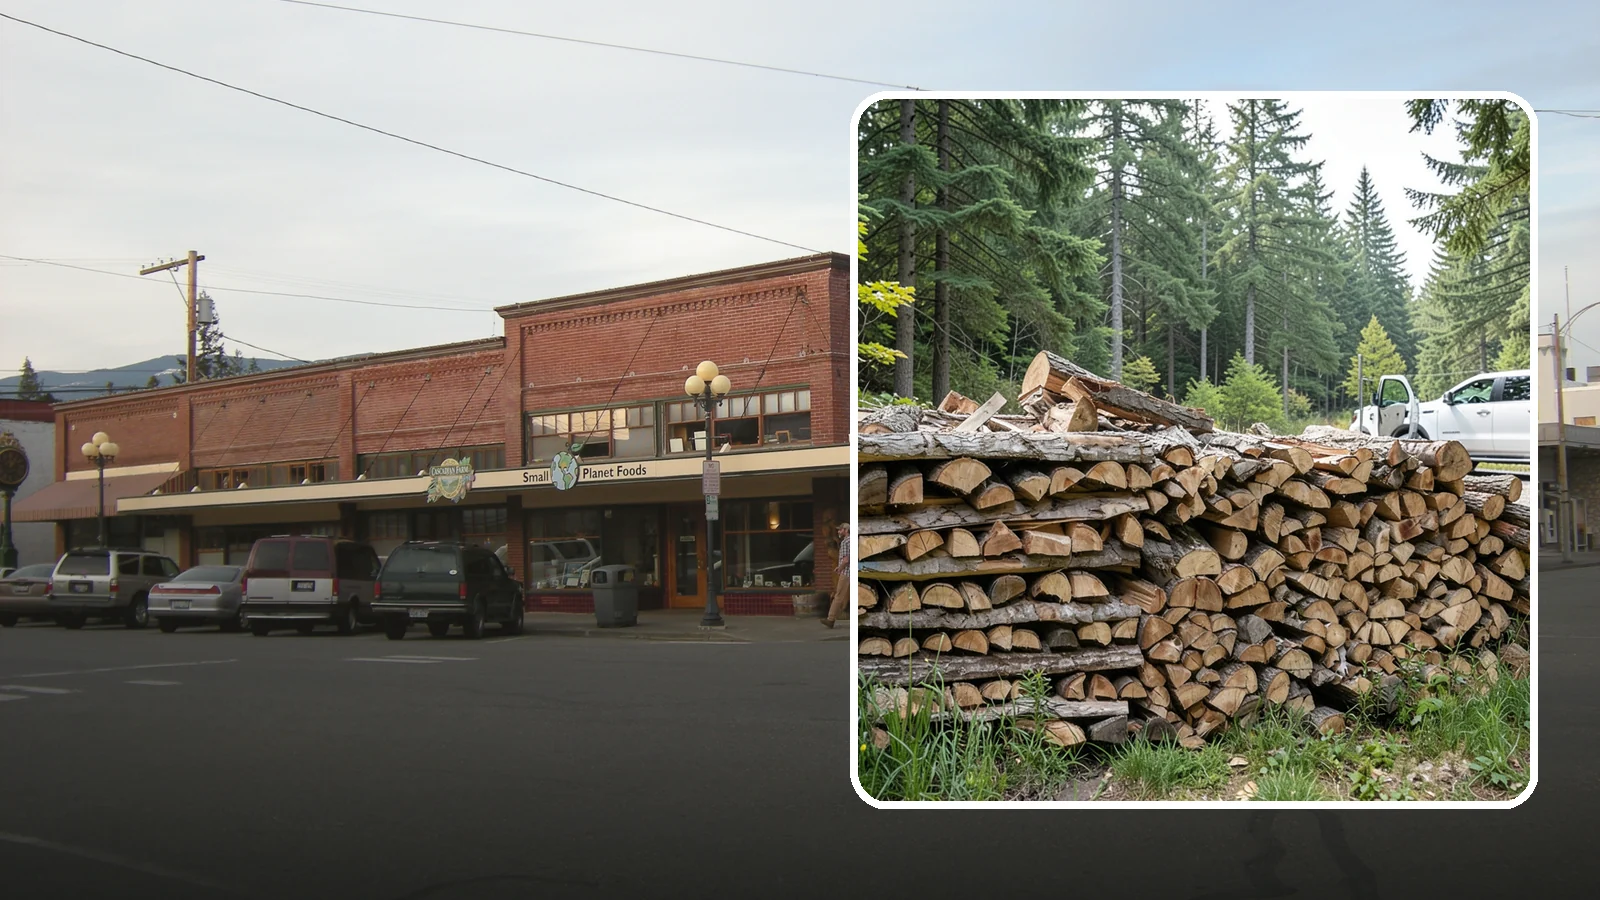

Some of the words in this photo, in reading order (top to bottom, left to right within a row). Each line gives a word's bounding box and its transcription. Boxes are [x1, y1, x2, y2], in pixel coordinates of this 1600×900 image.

[523, 470, 549, 483] Small
[583, 467, 614, 480] Planet
[617, 464, 647, 477] Foods
